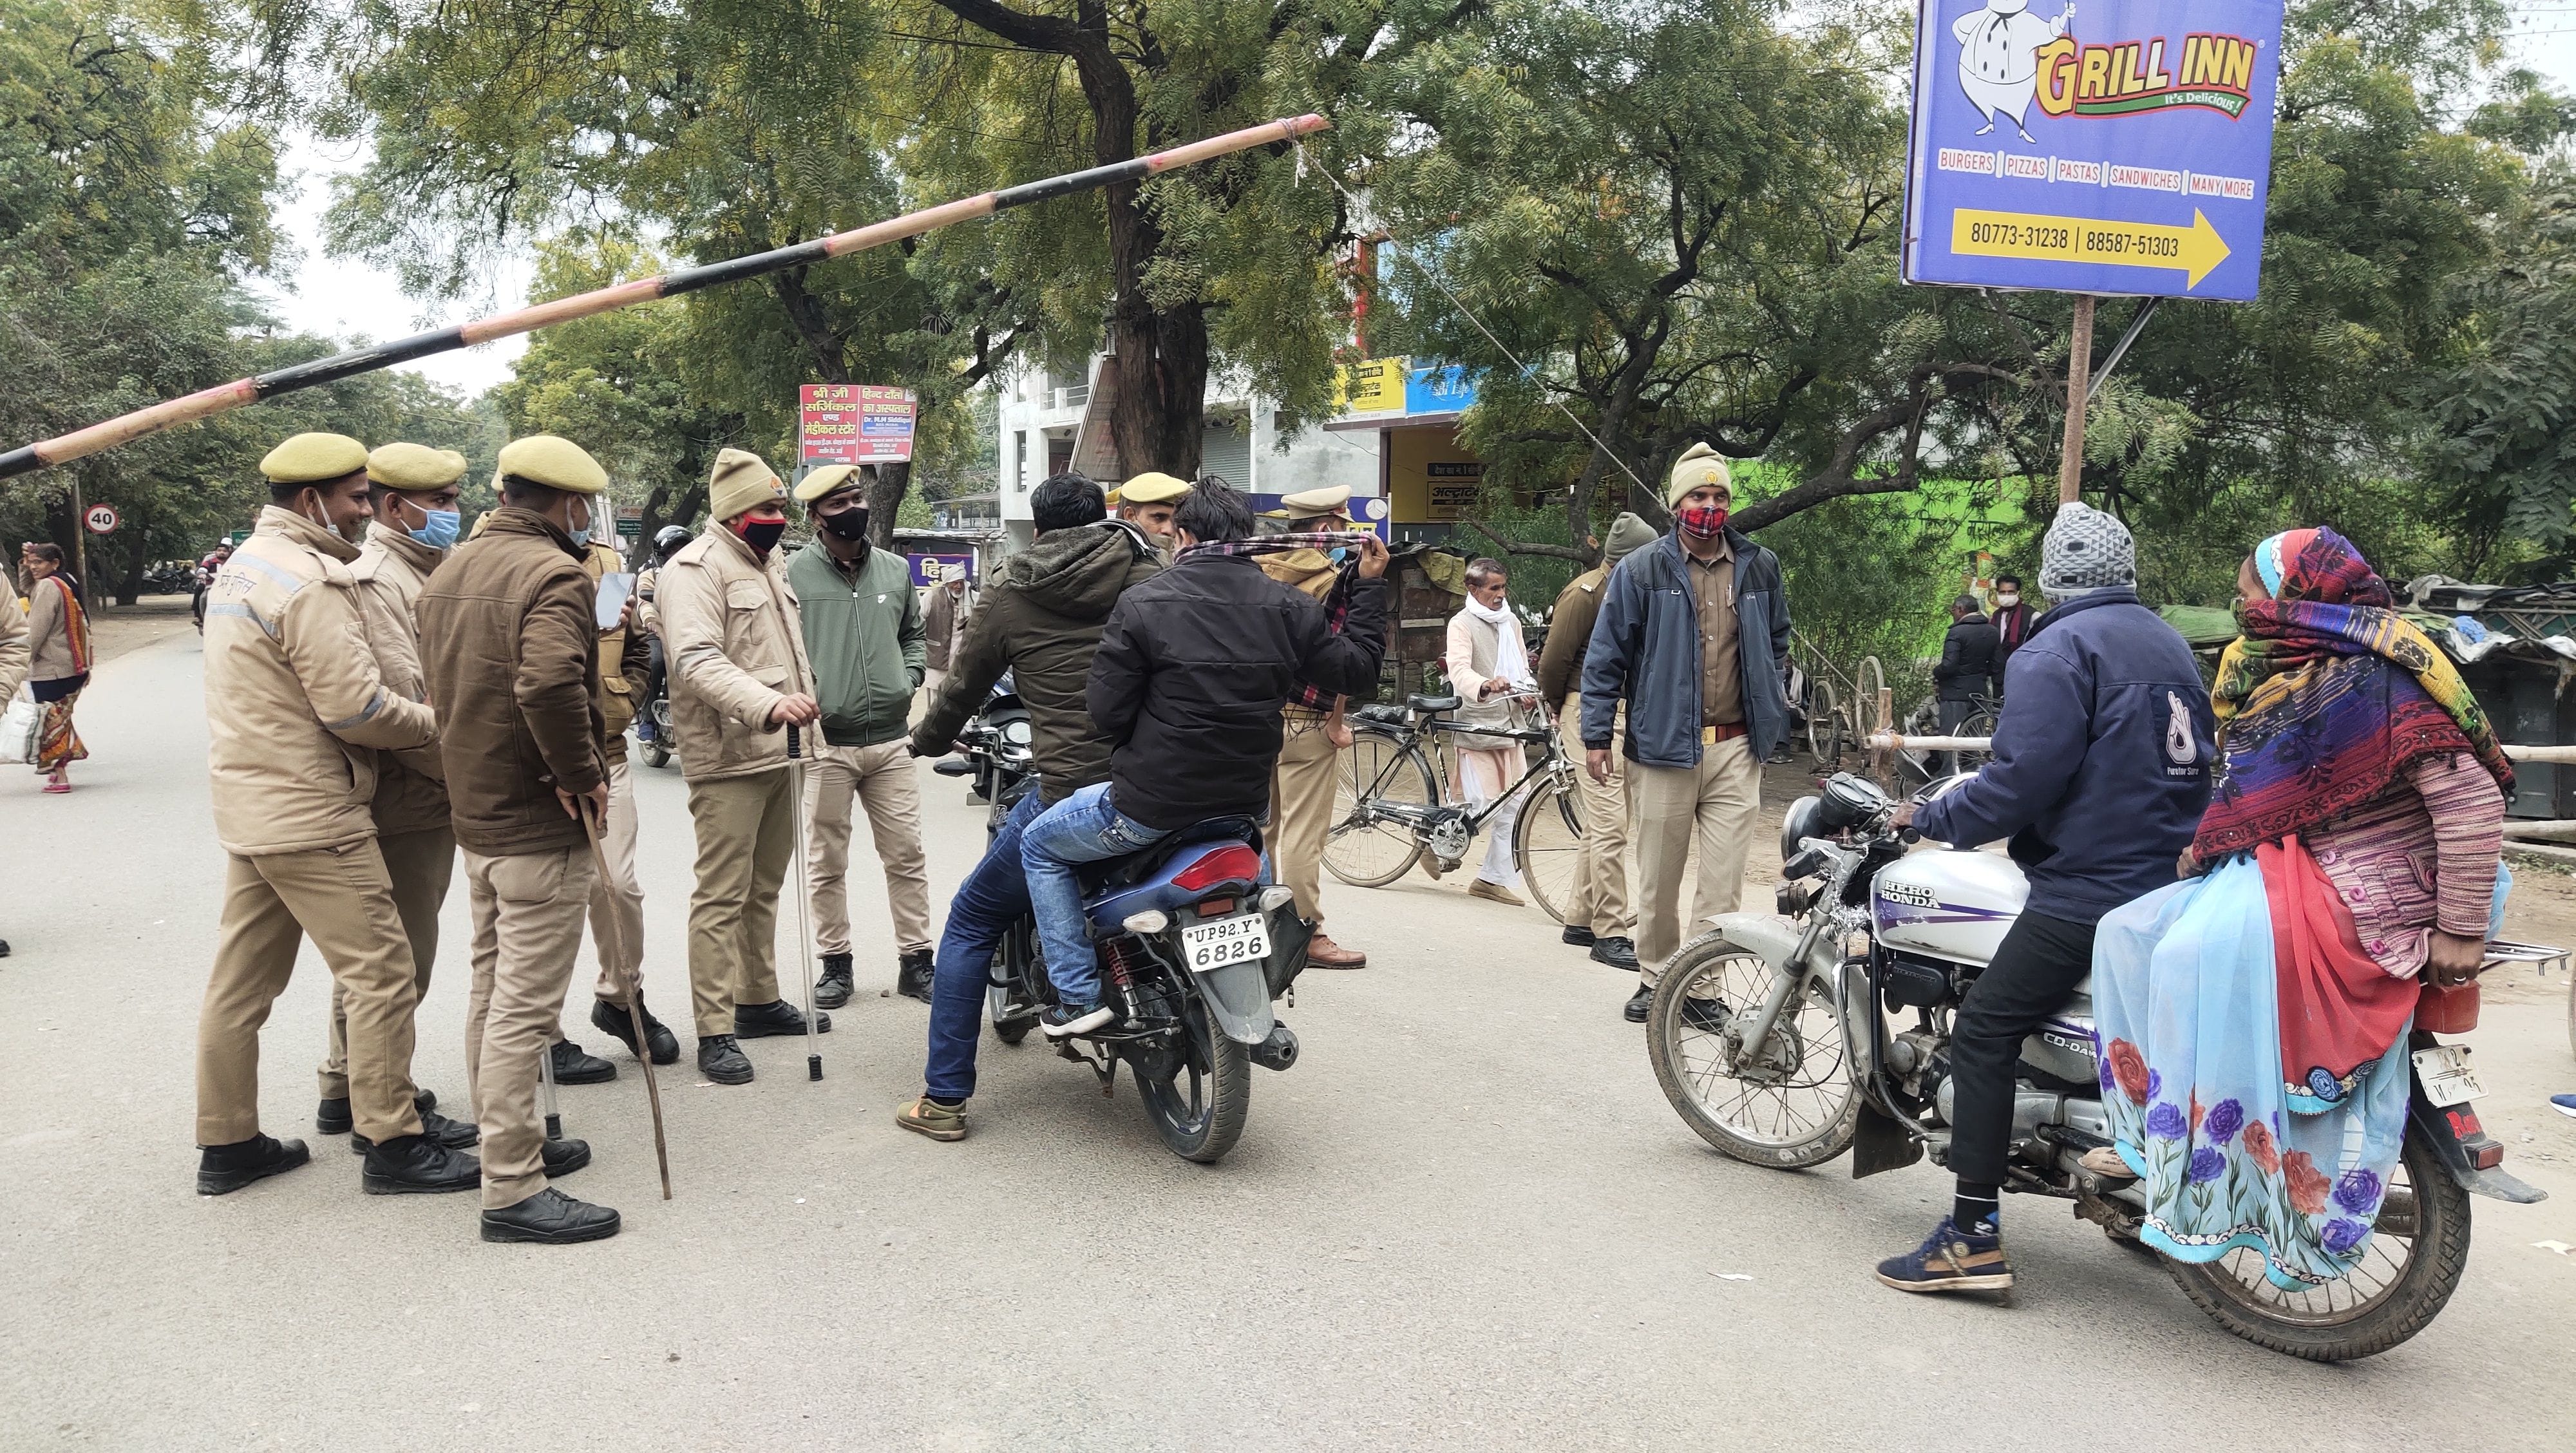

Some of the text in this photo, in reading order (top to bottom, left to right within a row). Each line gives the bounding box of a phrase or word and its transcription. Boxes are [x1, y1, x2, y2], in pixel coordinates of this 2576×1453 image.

[2036, 36, 2254, 114] GRILL INN
[2165, 93, 2241, 114] It's Delicious!
[1940, 151, 2253, 197] BURGERS PIZZAS PASTAS SANDWICHES MANY MORE
[1971, 222, 2179, 257] 80773-31238 88587-51303
[813, 387, 849, 398] श्री जी
[862, 388, 882, 399] हिन्द
[805, 400, 857, 412] सर्जिकल
[862, 404, 912, 414] का अस्पताल
[838, 421, 857, 435] स्टोर
[91, 513, 112, 525] 40
[1885, 880, 1935, 897] HERO
[1881, 889, 1941, 909] HONDA
[1196, 936, 1262, 965] 6826
